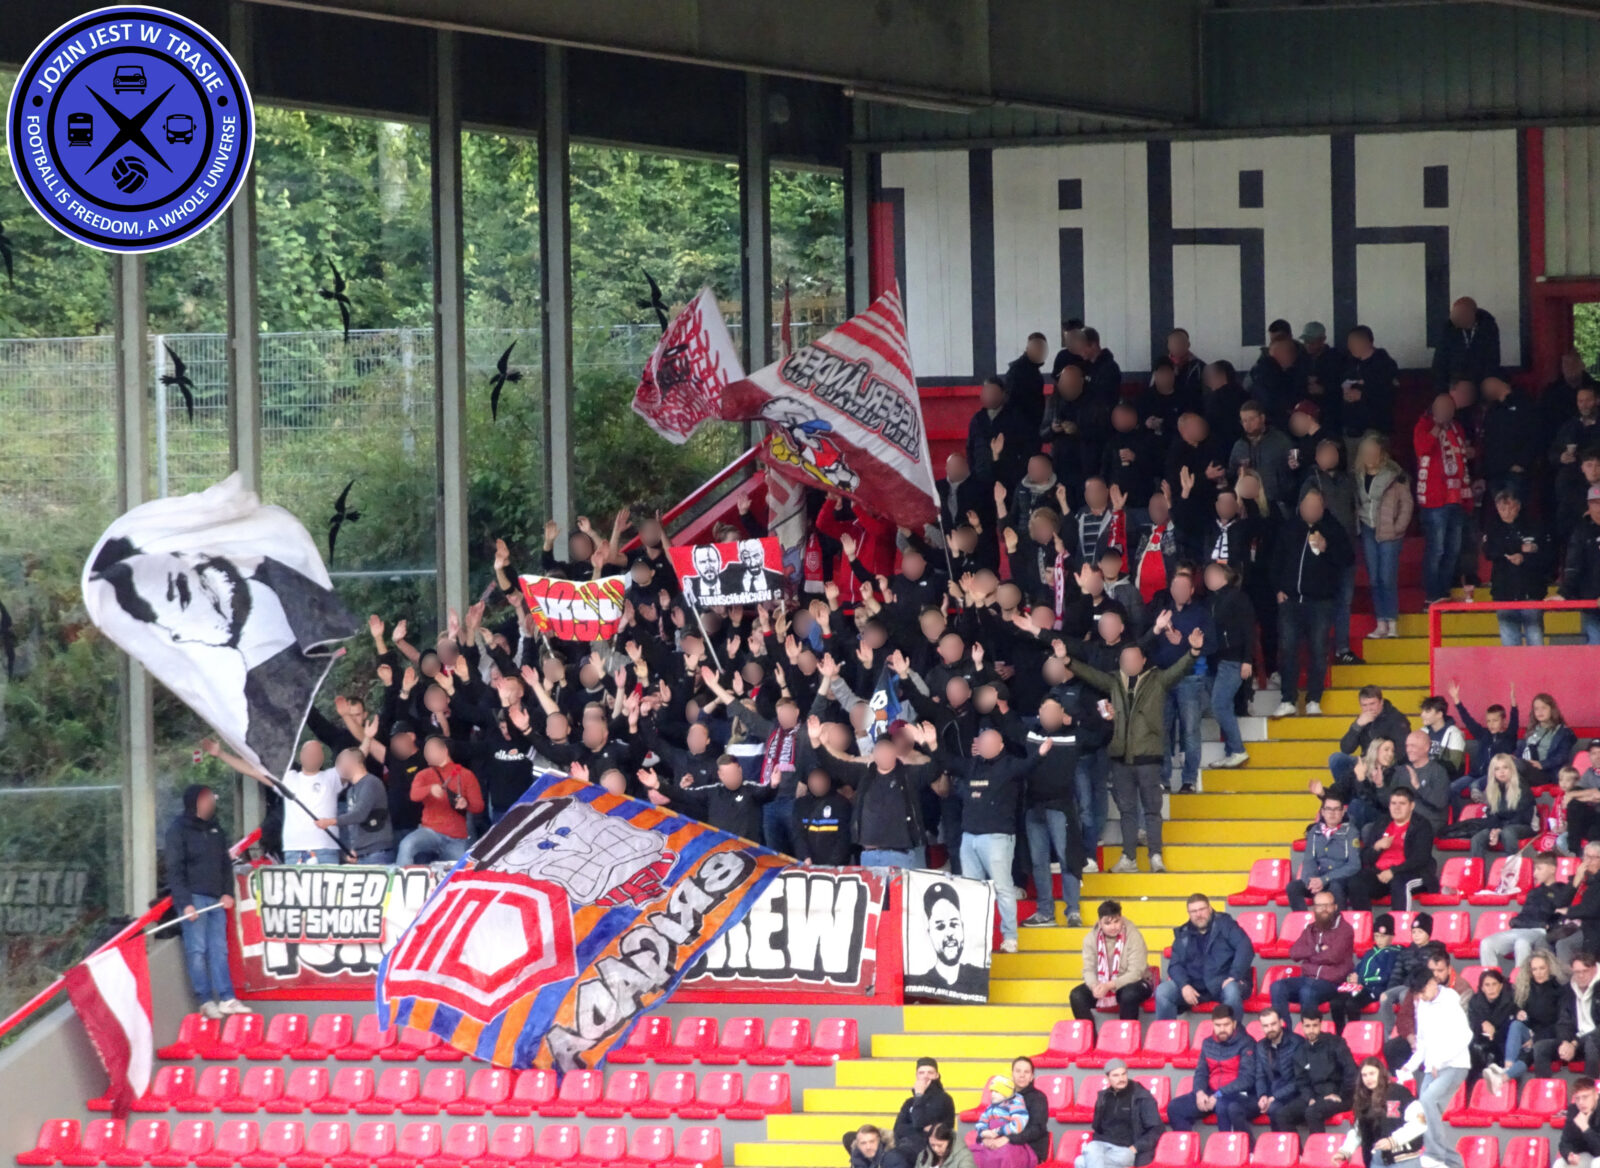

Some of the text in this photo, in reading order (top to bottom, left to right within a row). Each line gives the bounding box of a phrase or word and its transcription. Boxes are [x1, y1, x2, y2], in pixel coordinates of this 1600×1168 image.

[880, 128, 1520, 377] 1899
[261, 870, 389, 907] UNITED
[263, 907, 381, 934] WE SMOKE
